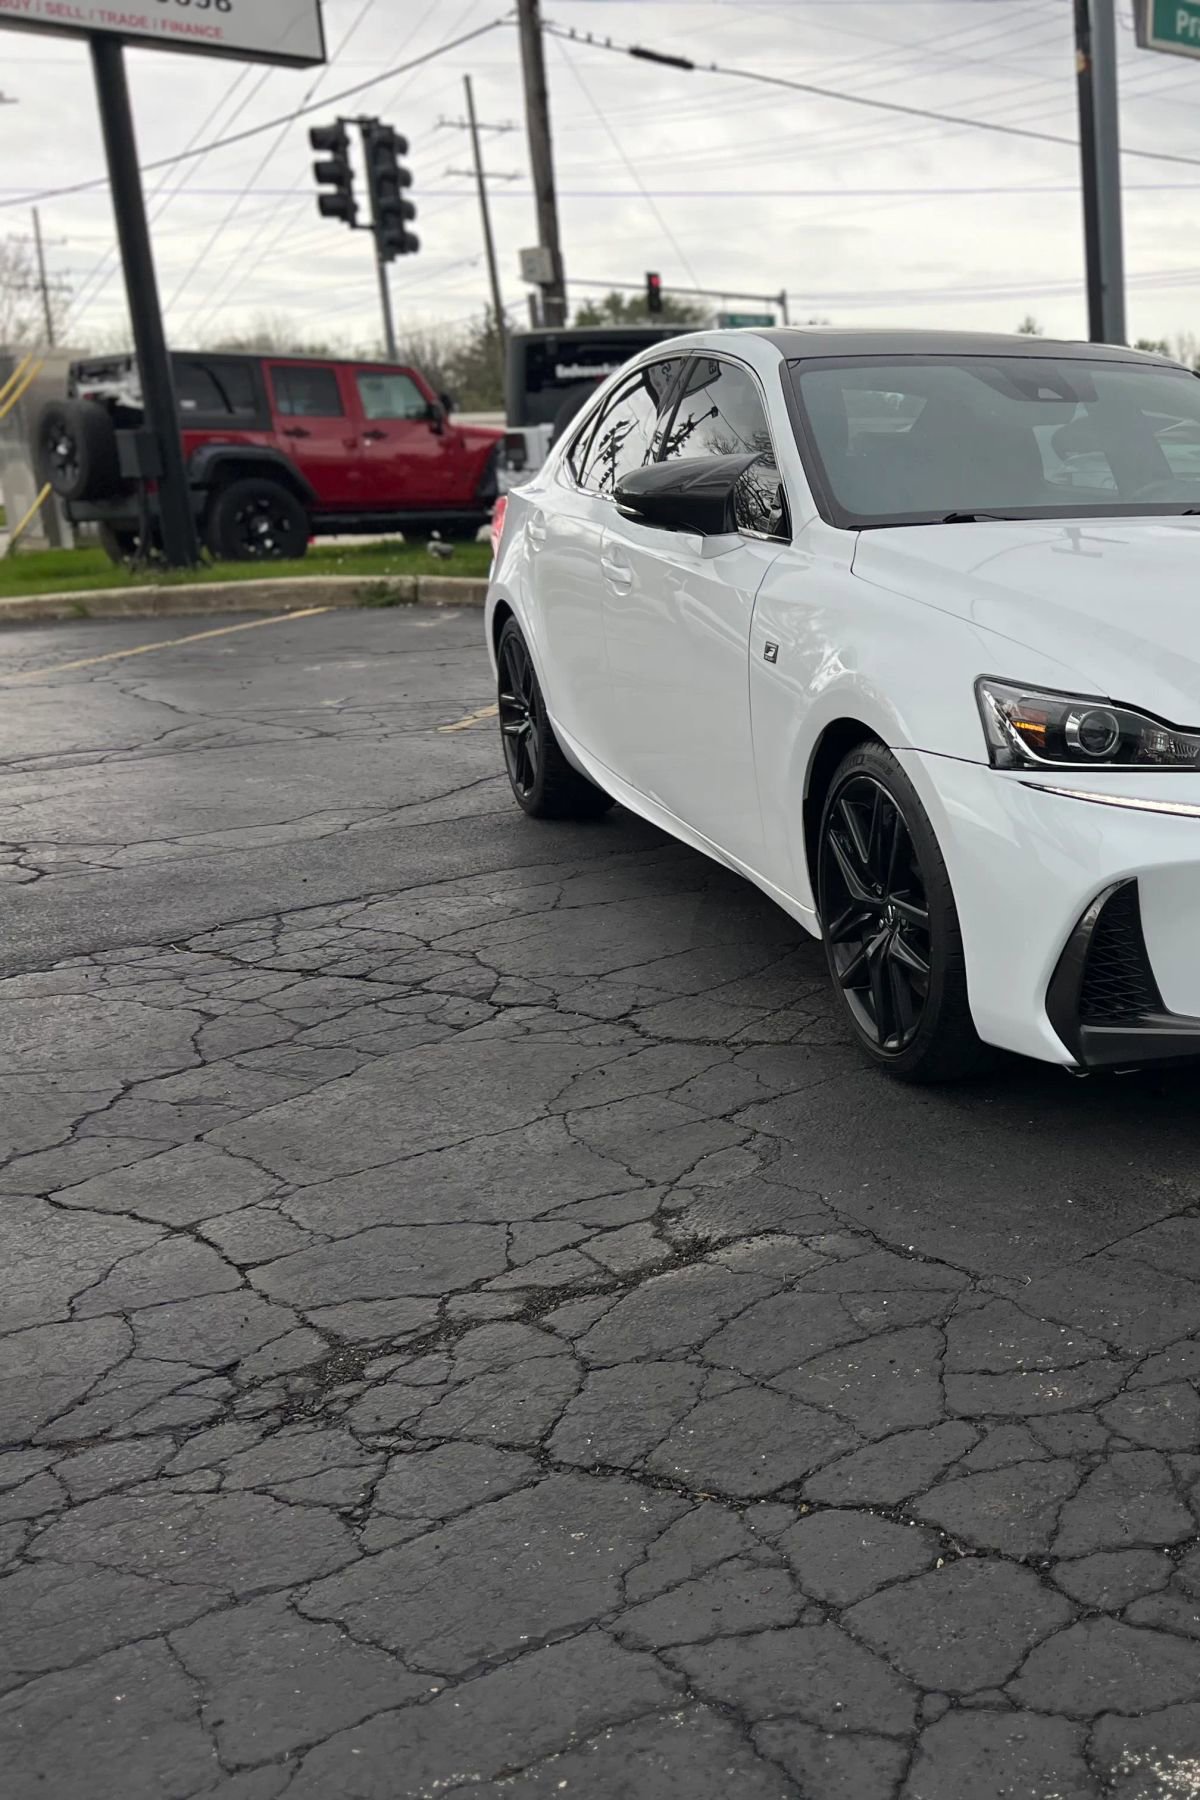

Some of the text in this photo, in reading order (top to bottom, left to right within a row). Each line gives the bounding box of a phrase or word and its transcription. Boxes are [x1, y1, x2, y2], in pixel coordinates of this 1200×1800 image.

[44, 1, 83, 19] SELL
[98, 8, 150, 29] TRADE
[161, 18, 224, 39] FINANCE
